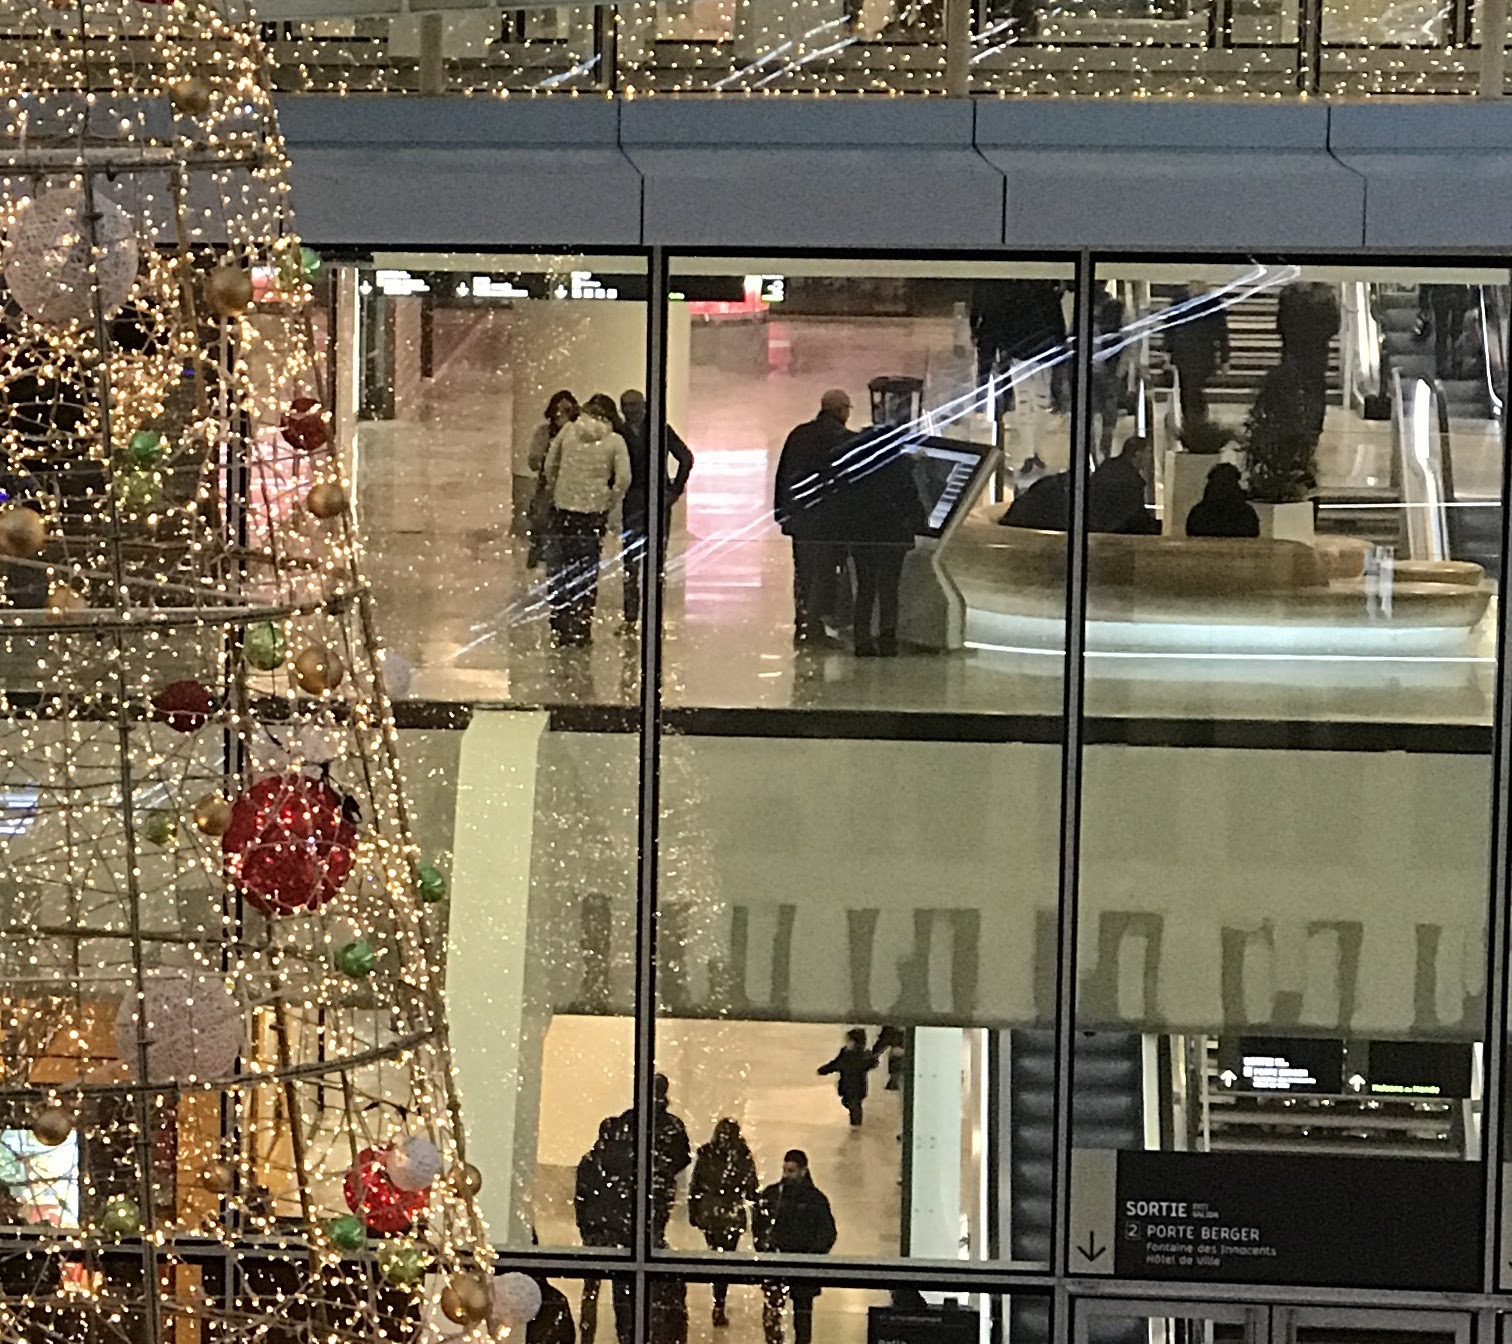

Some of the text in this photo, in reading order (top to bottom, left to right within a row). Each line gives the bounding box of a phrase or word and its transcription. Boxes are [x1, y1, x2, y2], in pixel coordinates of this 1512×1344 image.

[1125, 1200, 1188, 1218] SORTIE
[1127, 1223, 1261, 1242] 2 PORTE BERGER
[1146, 1241, 1278, 1257] Fontaine des Innocents
[1178, 1255, 1193, 1266] de
